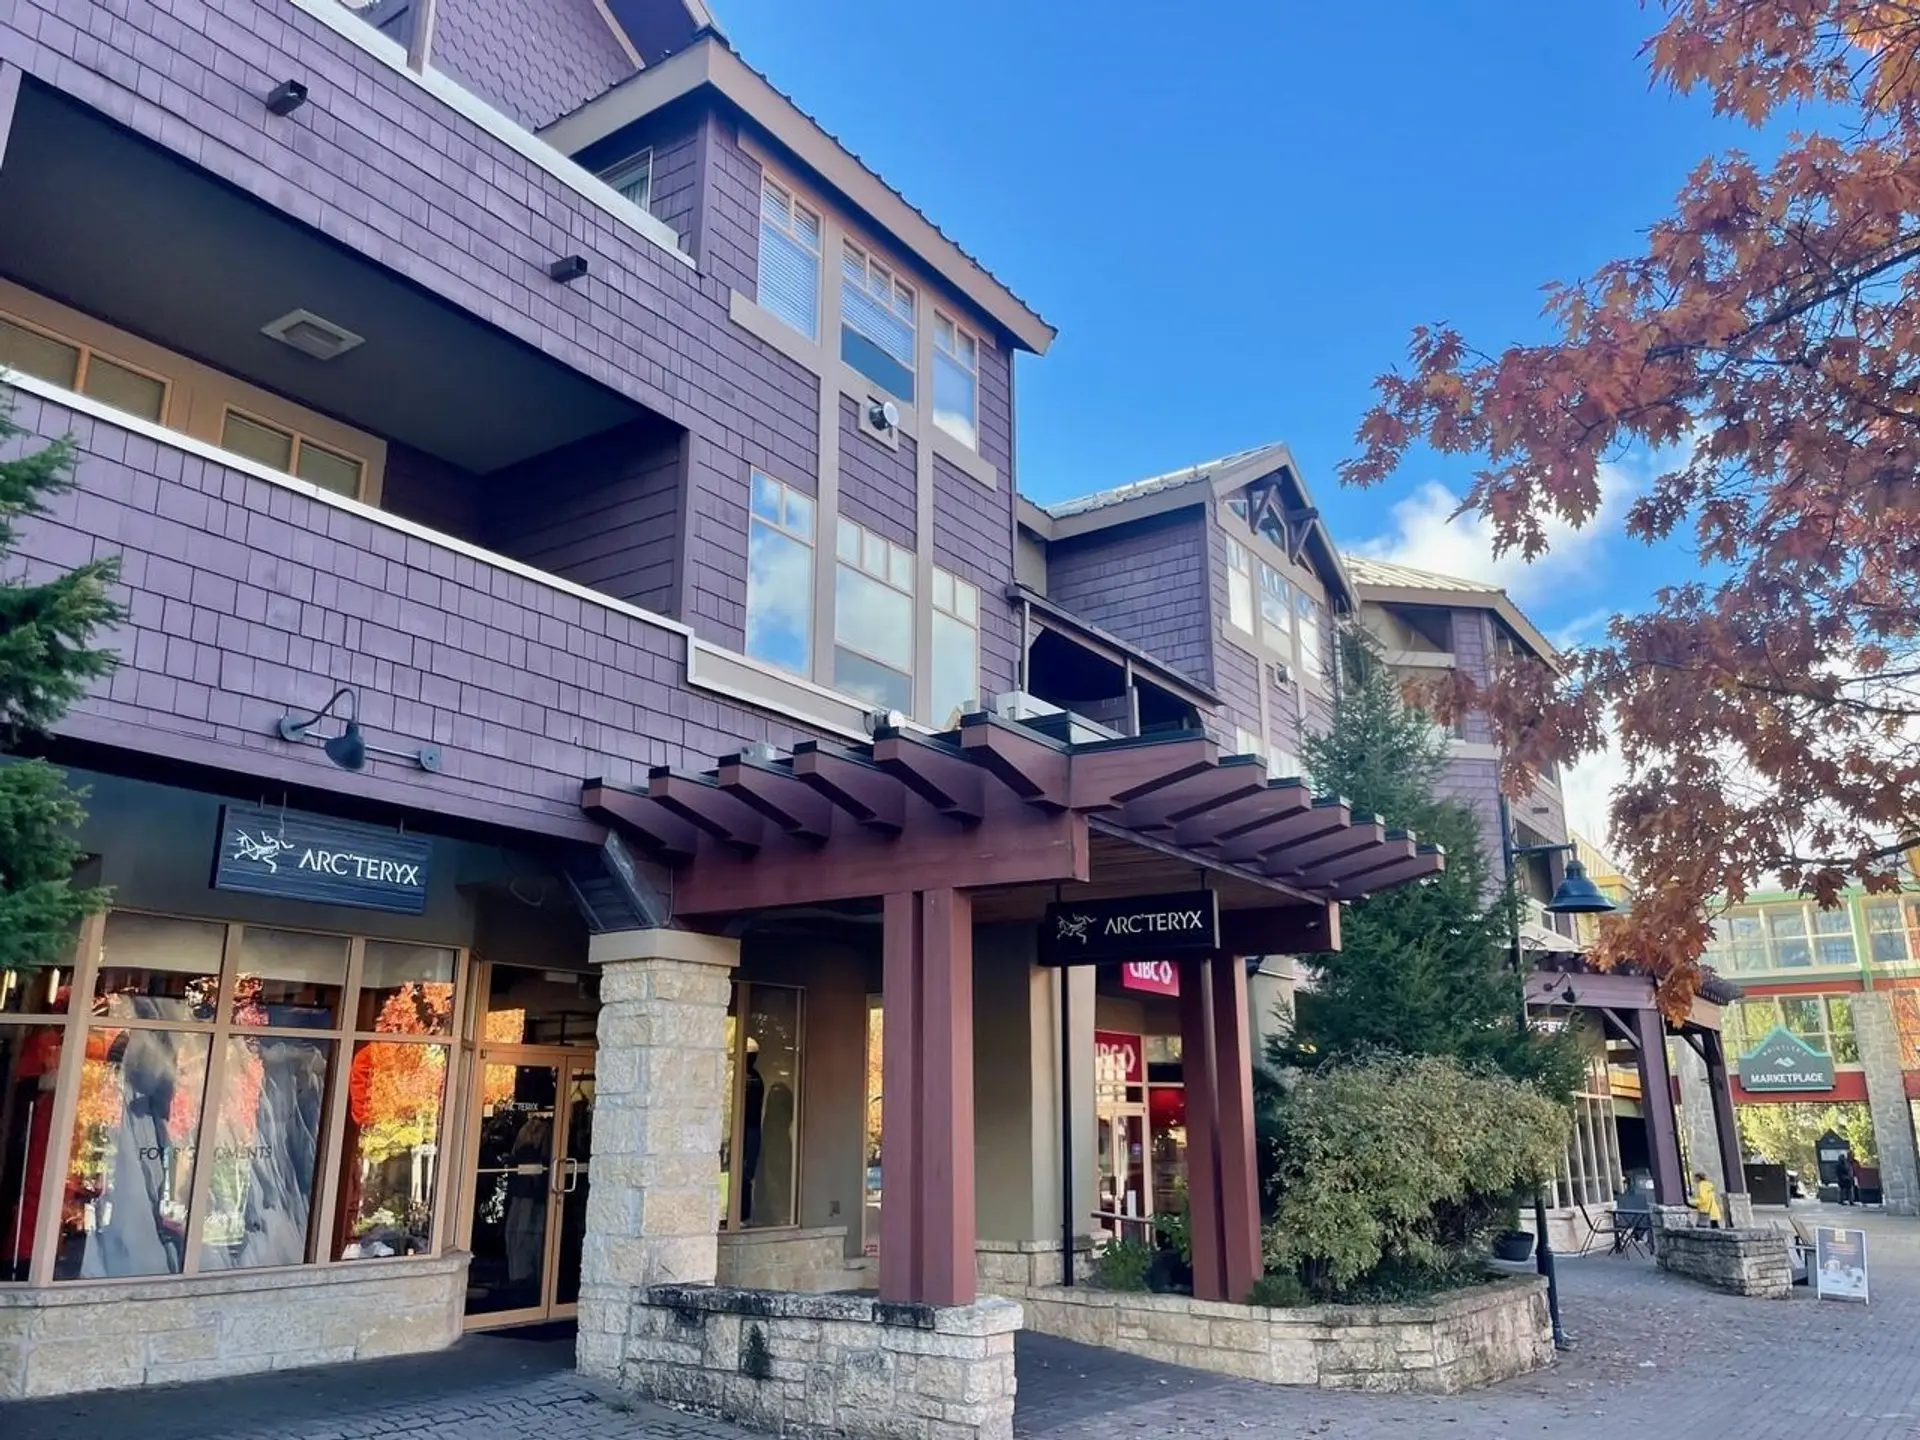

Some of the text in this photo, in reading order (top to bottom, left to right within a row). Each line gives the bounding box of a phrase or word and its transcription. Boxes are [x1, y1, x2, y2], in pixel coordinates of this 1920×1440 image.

[299, 848, 419, 886] ARC'TERYX
[1104, 911, 1203, 935] ARC'TERYX
[1750, 1072, 1824, 1083] MARKETPLACE
[139, 1146, 167, 1161] FO
[211, 1145, 272, 1160] OMENTS
